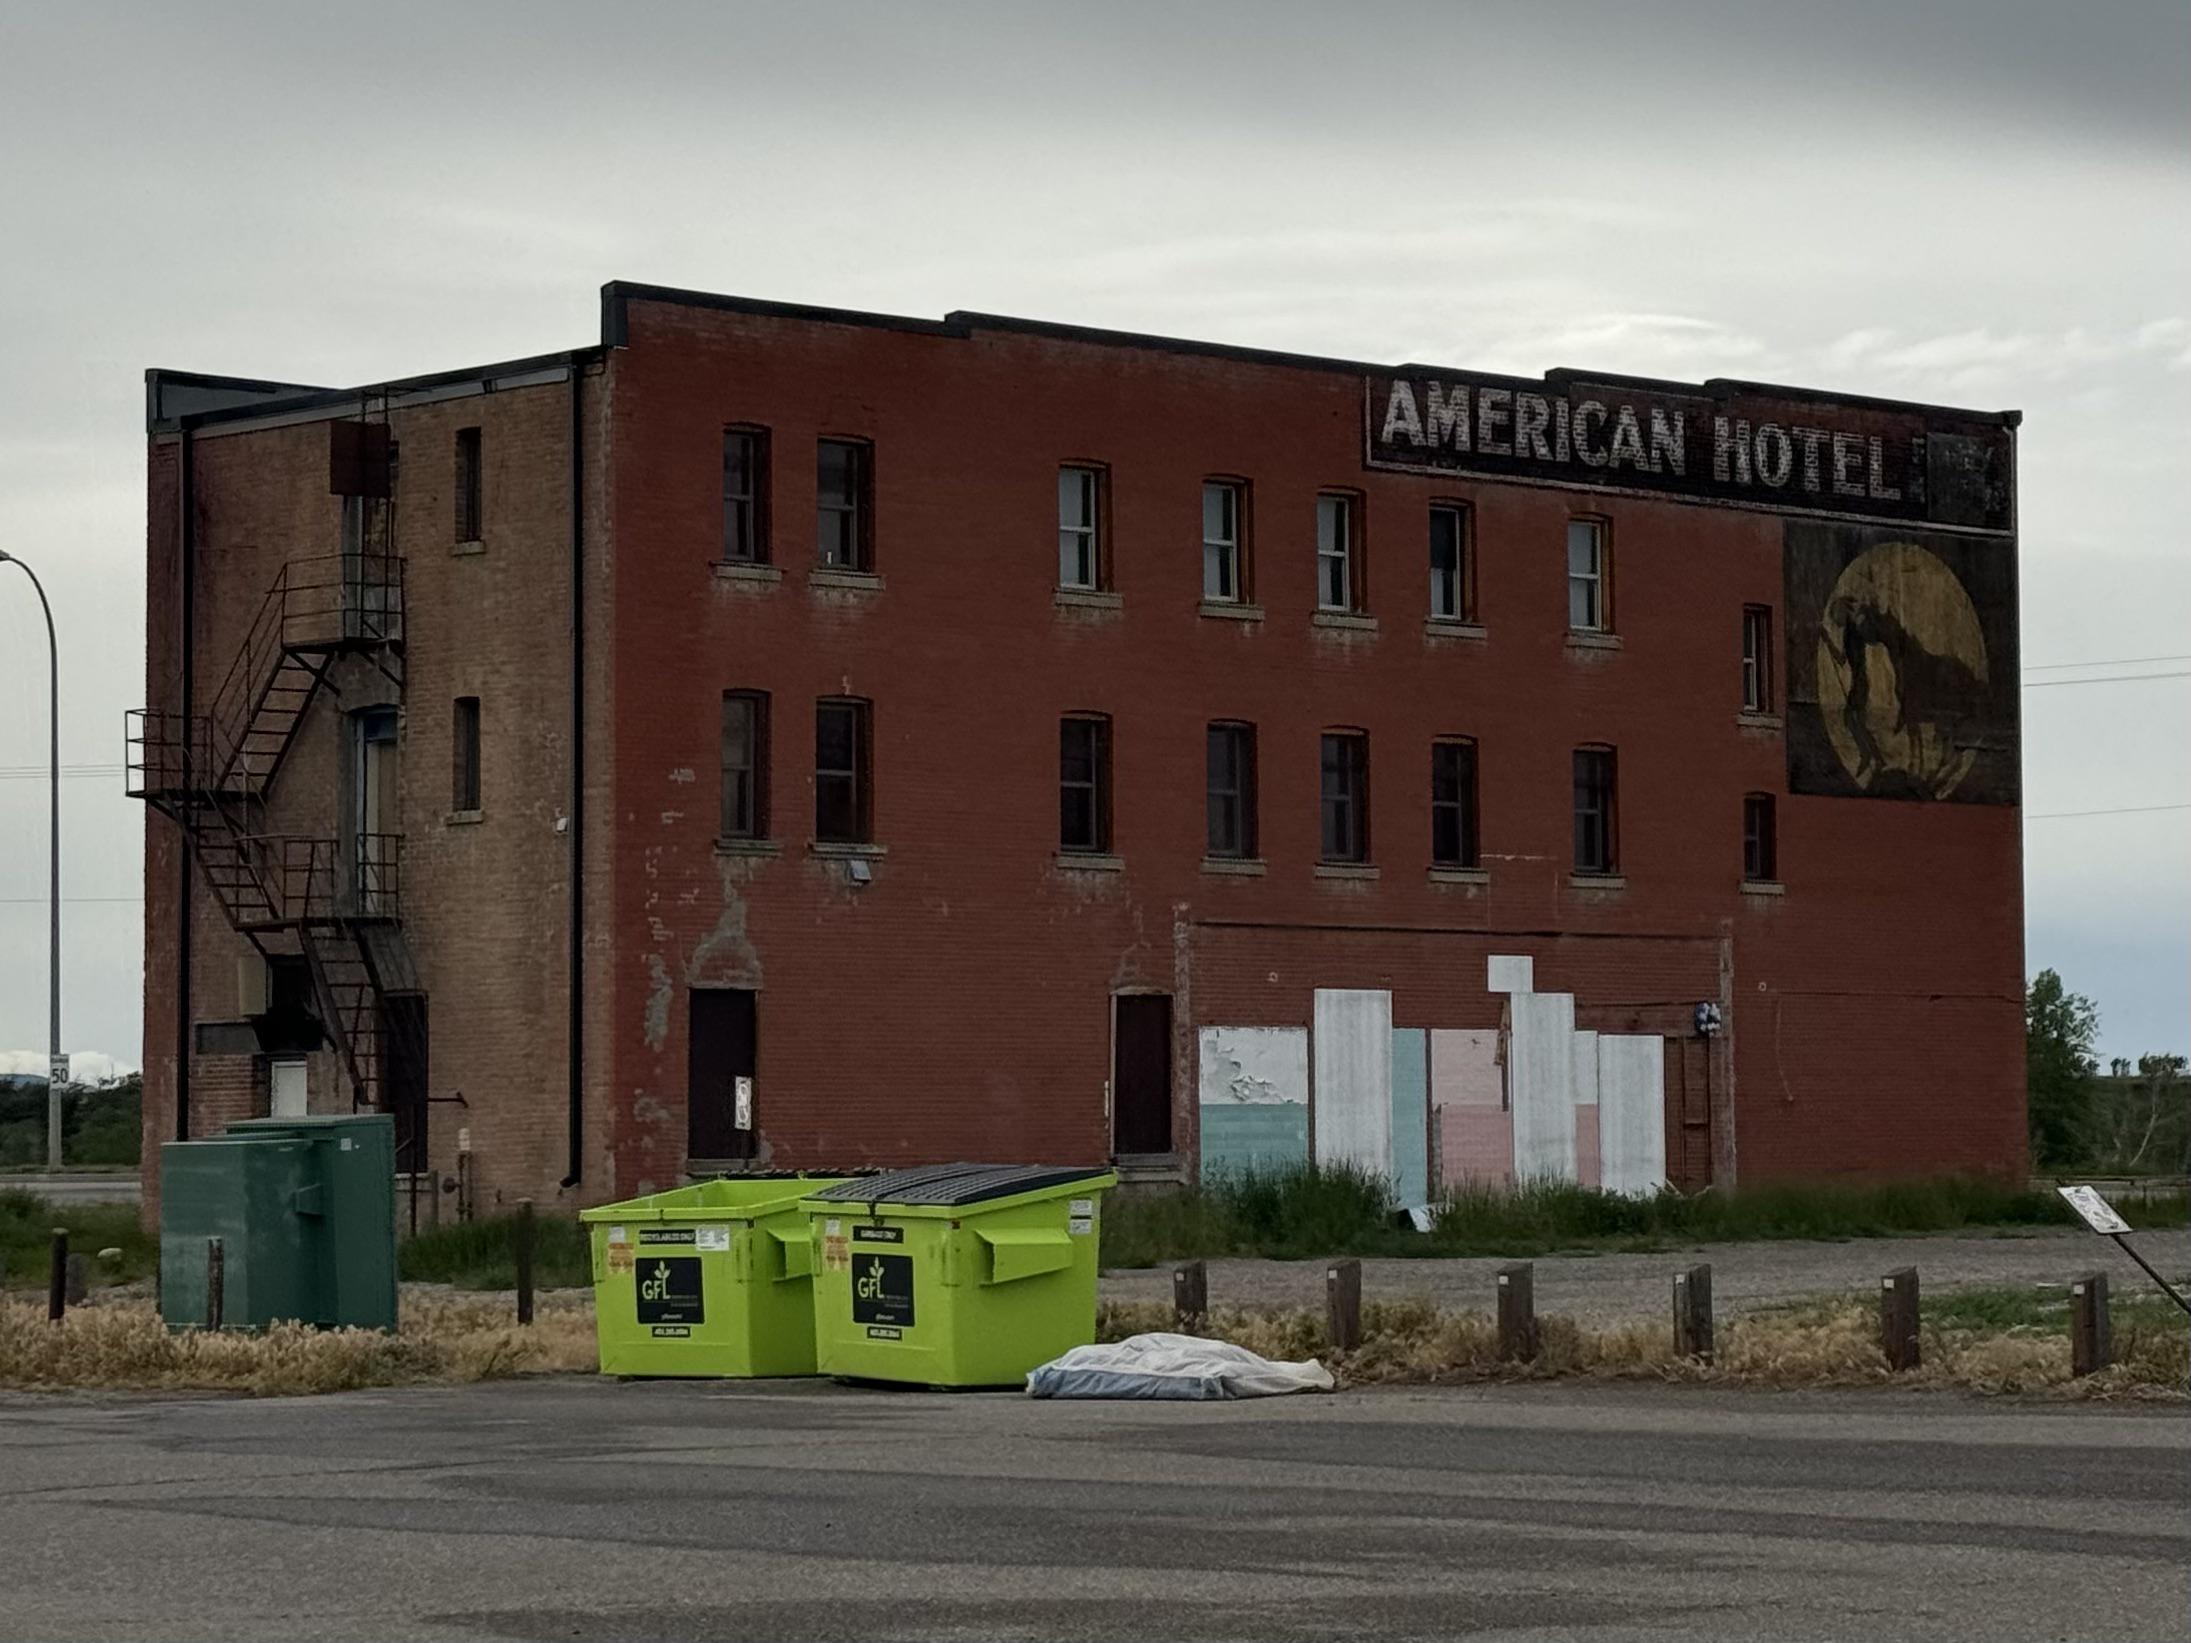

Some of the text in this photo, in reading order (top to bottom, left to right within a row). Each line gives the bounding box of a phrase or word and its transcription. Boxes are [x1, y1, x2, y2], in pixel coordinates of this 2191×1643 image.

[1381, 379, 1686, 476] AMERICAN
[1713, 415, 1900, 501] HOTEL
[52, 1068, 68, 1083] 50
[642, 1275, 671, 1299] GFL
[858, 1273, 885, 1298] GFL
